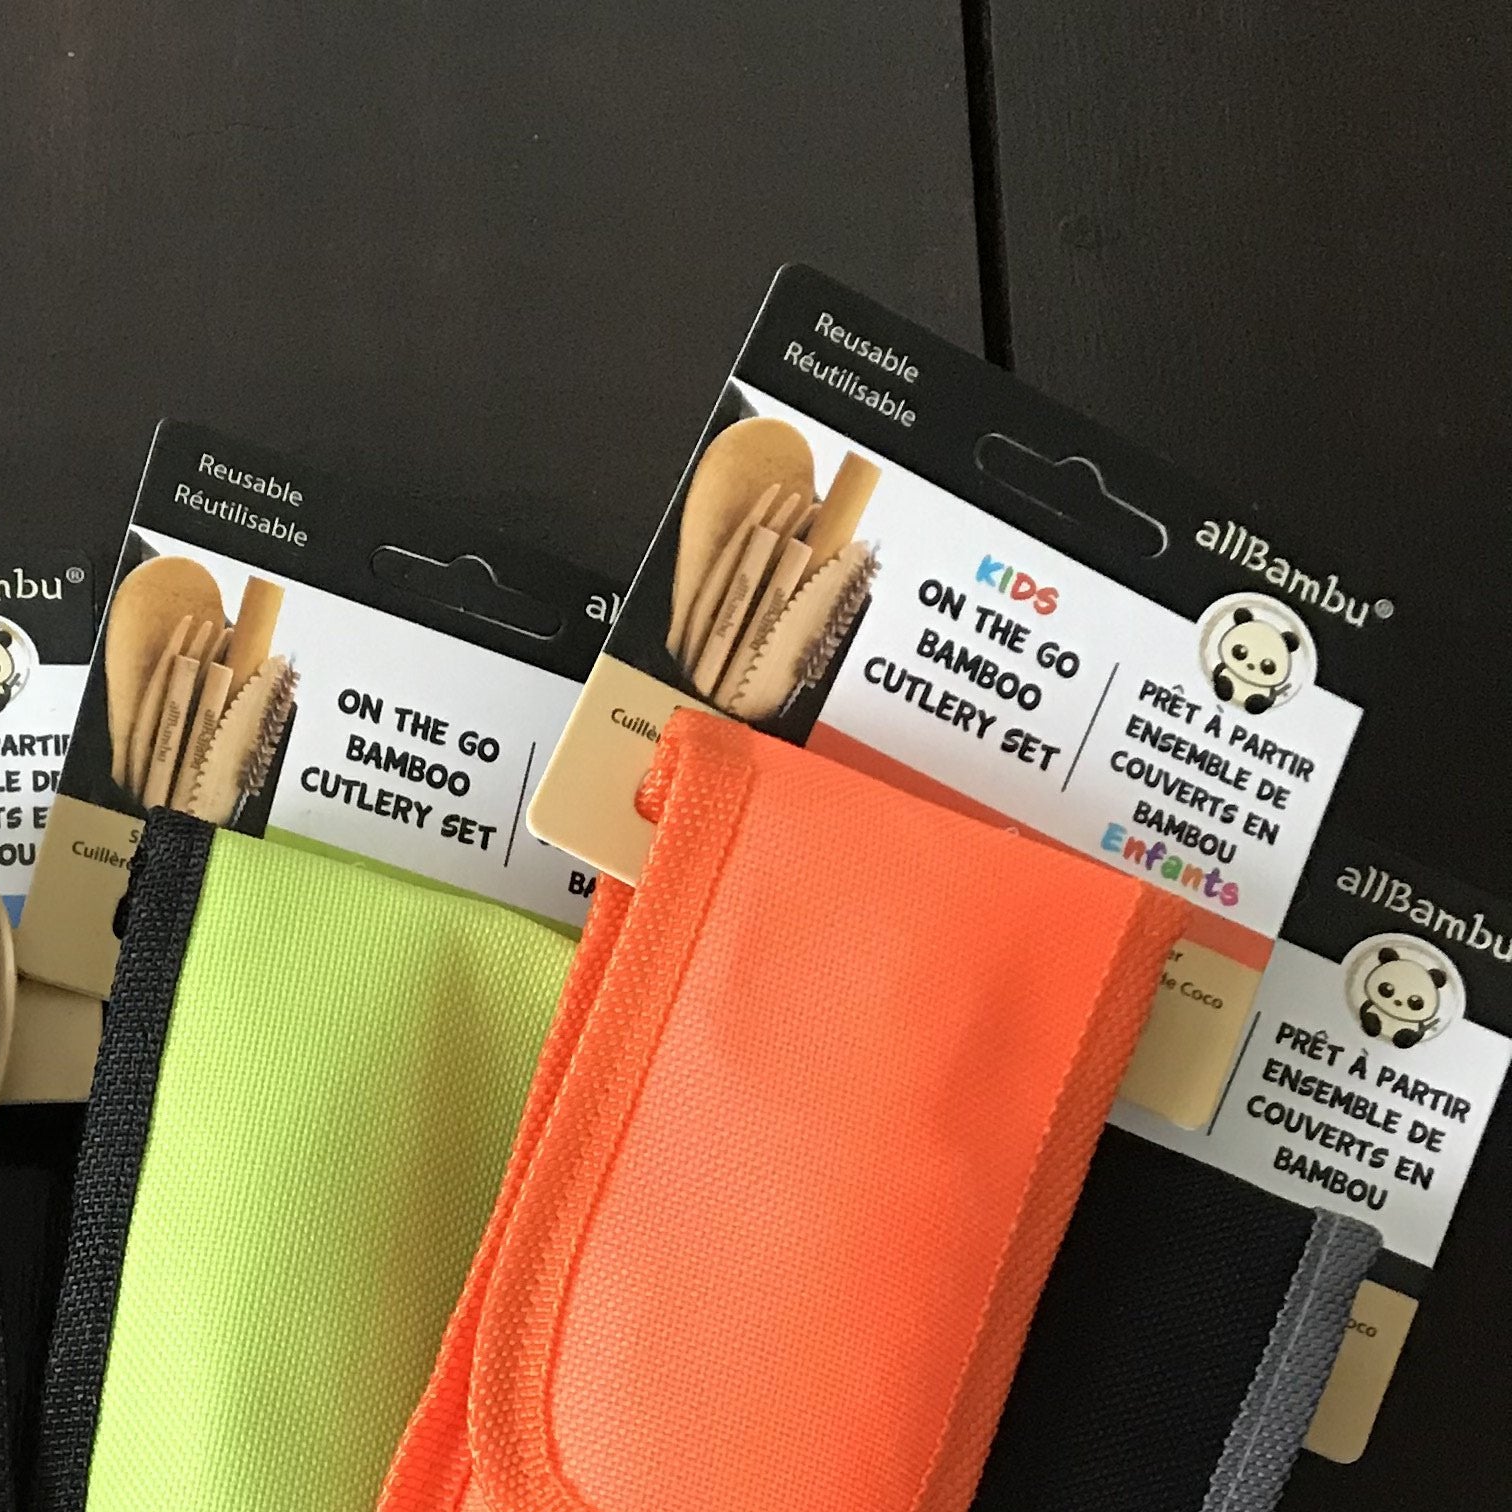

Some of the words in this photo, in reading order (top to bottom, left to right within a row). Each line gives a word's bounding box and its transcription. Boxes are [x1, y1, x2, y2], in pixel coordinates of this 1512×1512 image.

[784, 341, 916, 427] Réutilisable
[814, 312, 919, 383] Reusable
[174, 483, 308, 547] Réutilisable
[198, 453, 303, 507] Reusable
[975, 554, 1059, 615] KIDS
[916, 628, 1042, 710] BAMBOO
[918, 579, 966, 621] ON
[975, 605, 1032, 654] THE
[1037, 641, 1080, 678] GO
[338, 688, 383, 724] ON
[395, 707, 449, 745] THE
[458, 731, 500, 762] GO
[864, 656, 997, 739] CUTLERY
[1000, 728, 1061, 771] SET
[1139, 679, 1201, 724] PRÊT
[1204, 704, 1224, 738] À
[1229, 725, 1315, 782] PARTIR
[346, 734, 470, 797] BAMBOO
[1110, 751, 1238, 823] COUVERTS
[1243, 812, 1280, 845] EN
[1125, 714, 1252, 791] ENSEMBLE
[1256, 778, 1291, 810] DE
[301, 767, 432, 828] CUTLERY
[440, 814, 497, 850] SET
[1133, 800, 1237, 863] BAMBOU
[1100, 822, 1239, 906] Enfants
[1180, 981, 1223, 1009] Coco
[1262, 1058, 1402, 1133] ENSEMBLE
[1407, 1120, 1446, 1152] DE
[1275, 1022, 1344, 1066] PRÊT
[1348, 1048, 1368, 1080] À
[1376, 1065, 1471, 1123] PARTIR
[1247, 1095, 1389, 1168] COUVERTS
[1394, 1156, 1434, 1190] EN
[1273, 1146, 1388, 1210] BAMBOU
[1347, 1319, 1377, 1337] oco
